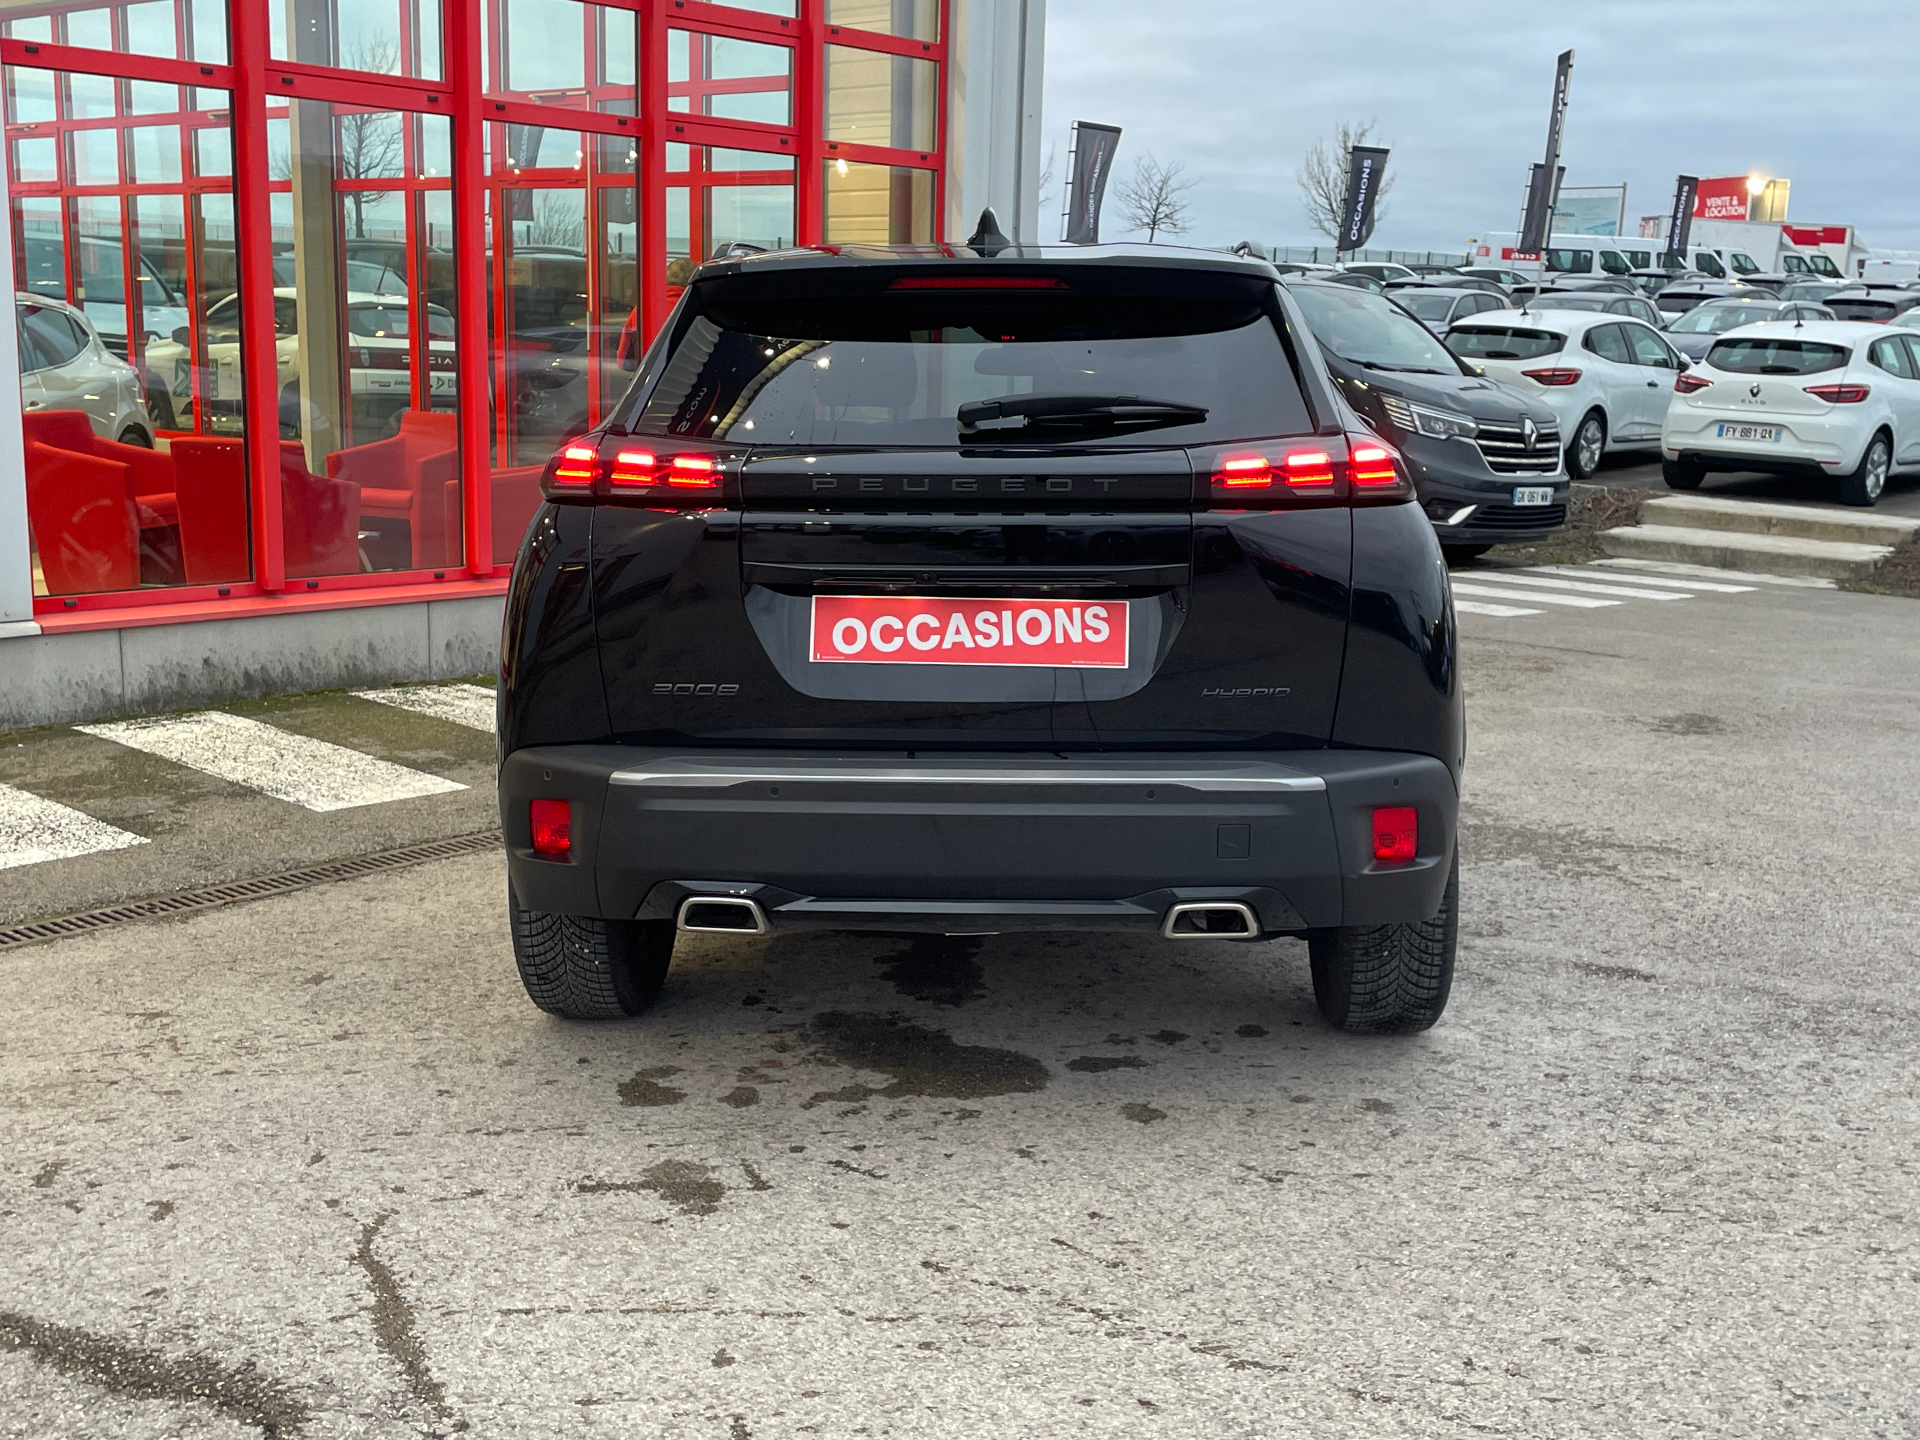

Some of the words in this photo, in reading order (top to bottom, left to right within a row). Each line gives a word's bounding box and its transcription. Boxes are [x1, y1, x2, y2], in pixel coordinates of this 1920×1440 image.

[1350, 159, 1372, 241] OCCASIONS
[1706, 197, 1731, 207] VENTE
[1731, 196, 1739, 205] &
[1672, 185, 1689, 249] OCCASIONS
[1705, 205, 1746, 217] LOCATION
[811, 478, 1119, 492] PEUGEOT
[832, 605, 1110, 655] OCCASIONS
[652, 683, 740, 696] 2008
[1201, 687, 1291, 699] HYBRID
